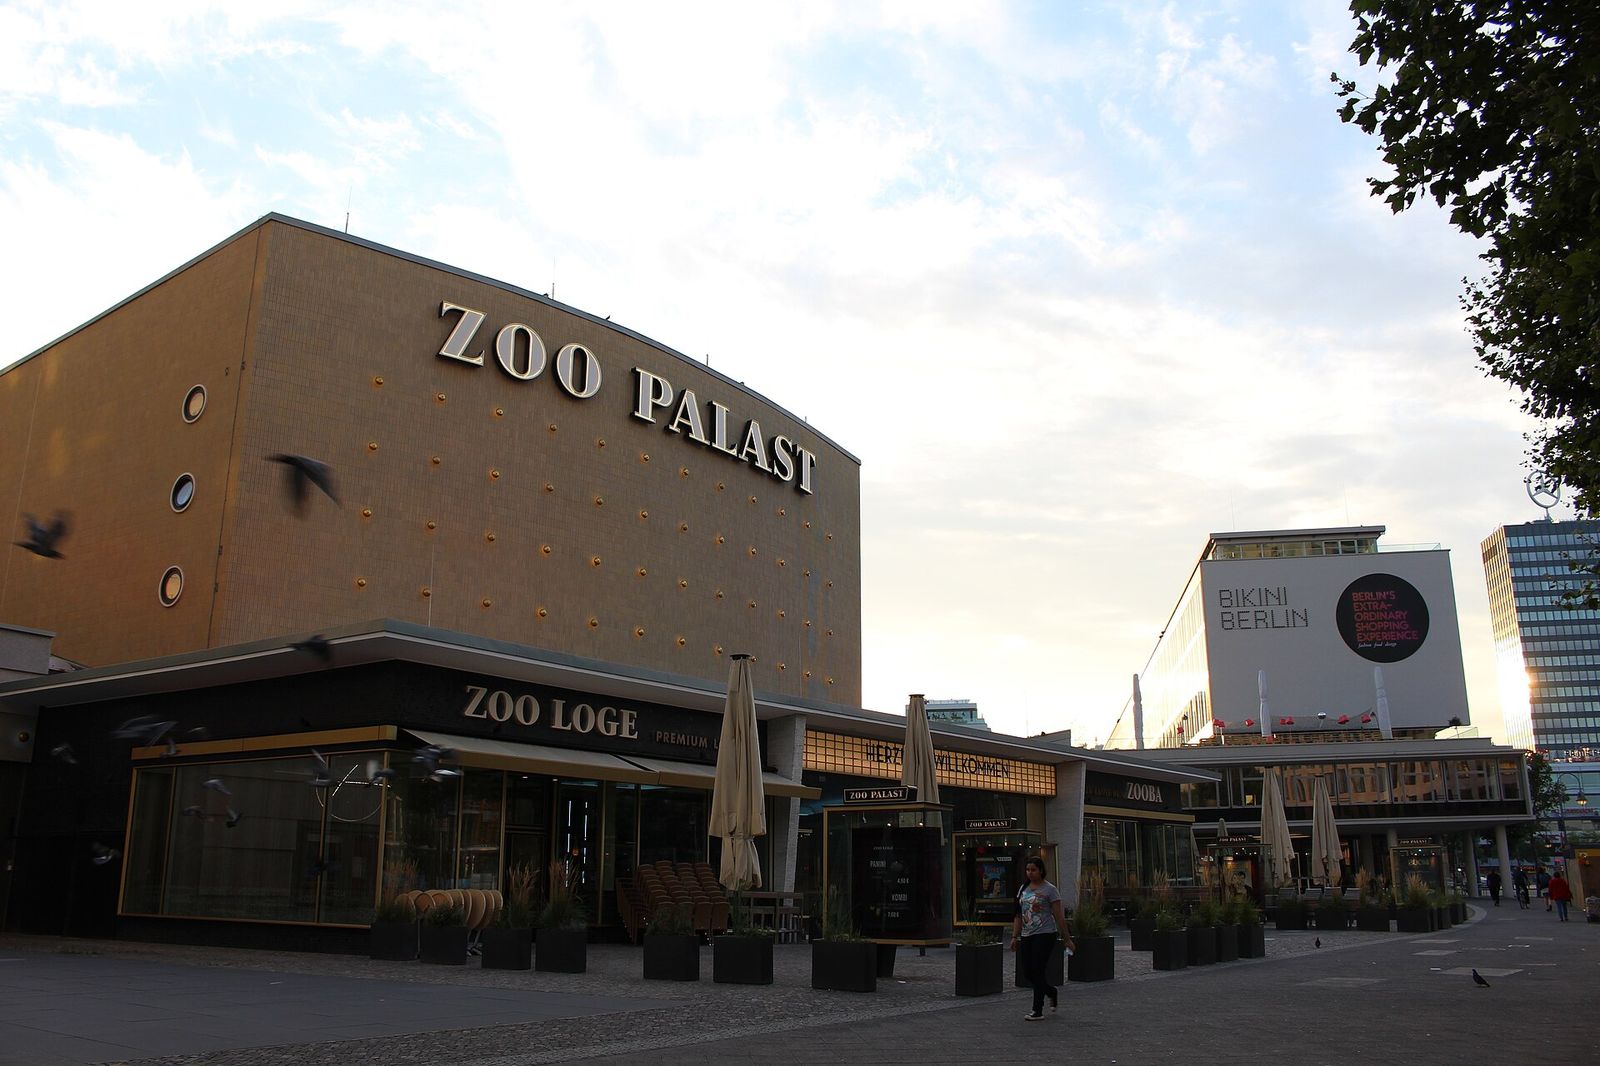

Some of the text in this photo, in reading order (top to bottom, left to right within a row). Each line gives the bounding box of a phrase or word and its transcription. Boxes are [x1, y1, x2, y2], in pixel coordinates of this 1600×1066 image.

[438, 300, 818, 496] ZOO PALAST
[1219, 586, 1288, 608] BIKINI
[1352, 590, 1396, 602] BERLIN'S
[1353, 601, 1393, 612] EXTRA-
[1221, 608, 1309, 630] BERLIN
[1354, 610, 1408, 621] ORDINARY
[1355, 620, 1409, 632] SHOPPING
[1356, 630, 1419, 641] EXPERIENCE
[464, 685, 639, 740] ZOO LOGE
[656, 730, 708, 749] PREMIUM
[866, 743, 1010, 778] HERZ WILLKOMMEN
[850, 789, 904, 799] ZOO PALAST
[1127, 782, 1163, 803] ZOOBA
[984, 820, 1009, 828] PALAST
